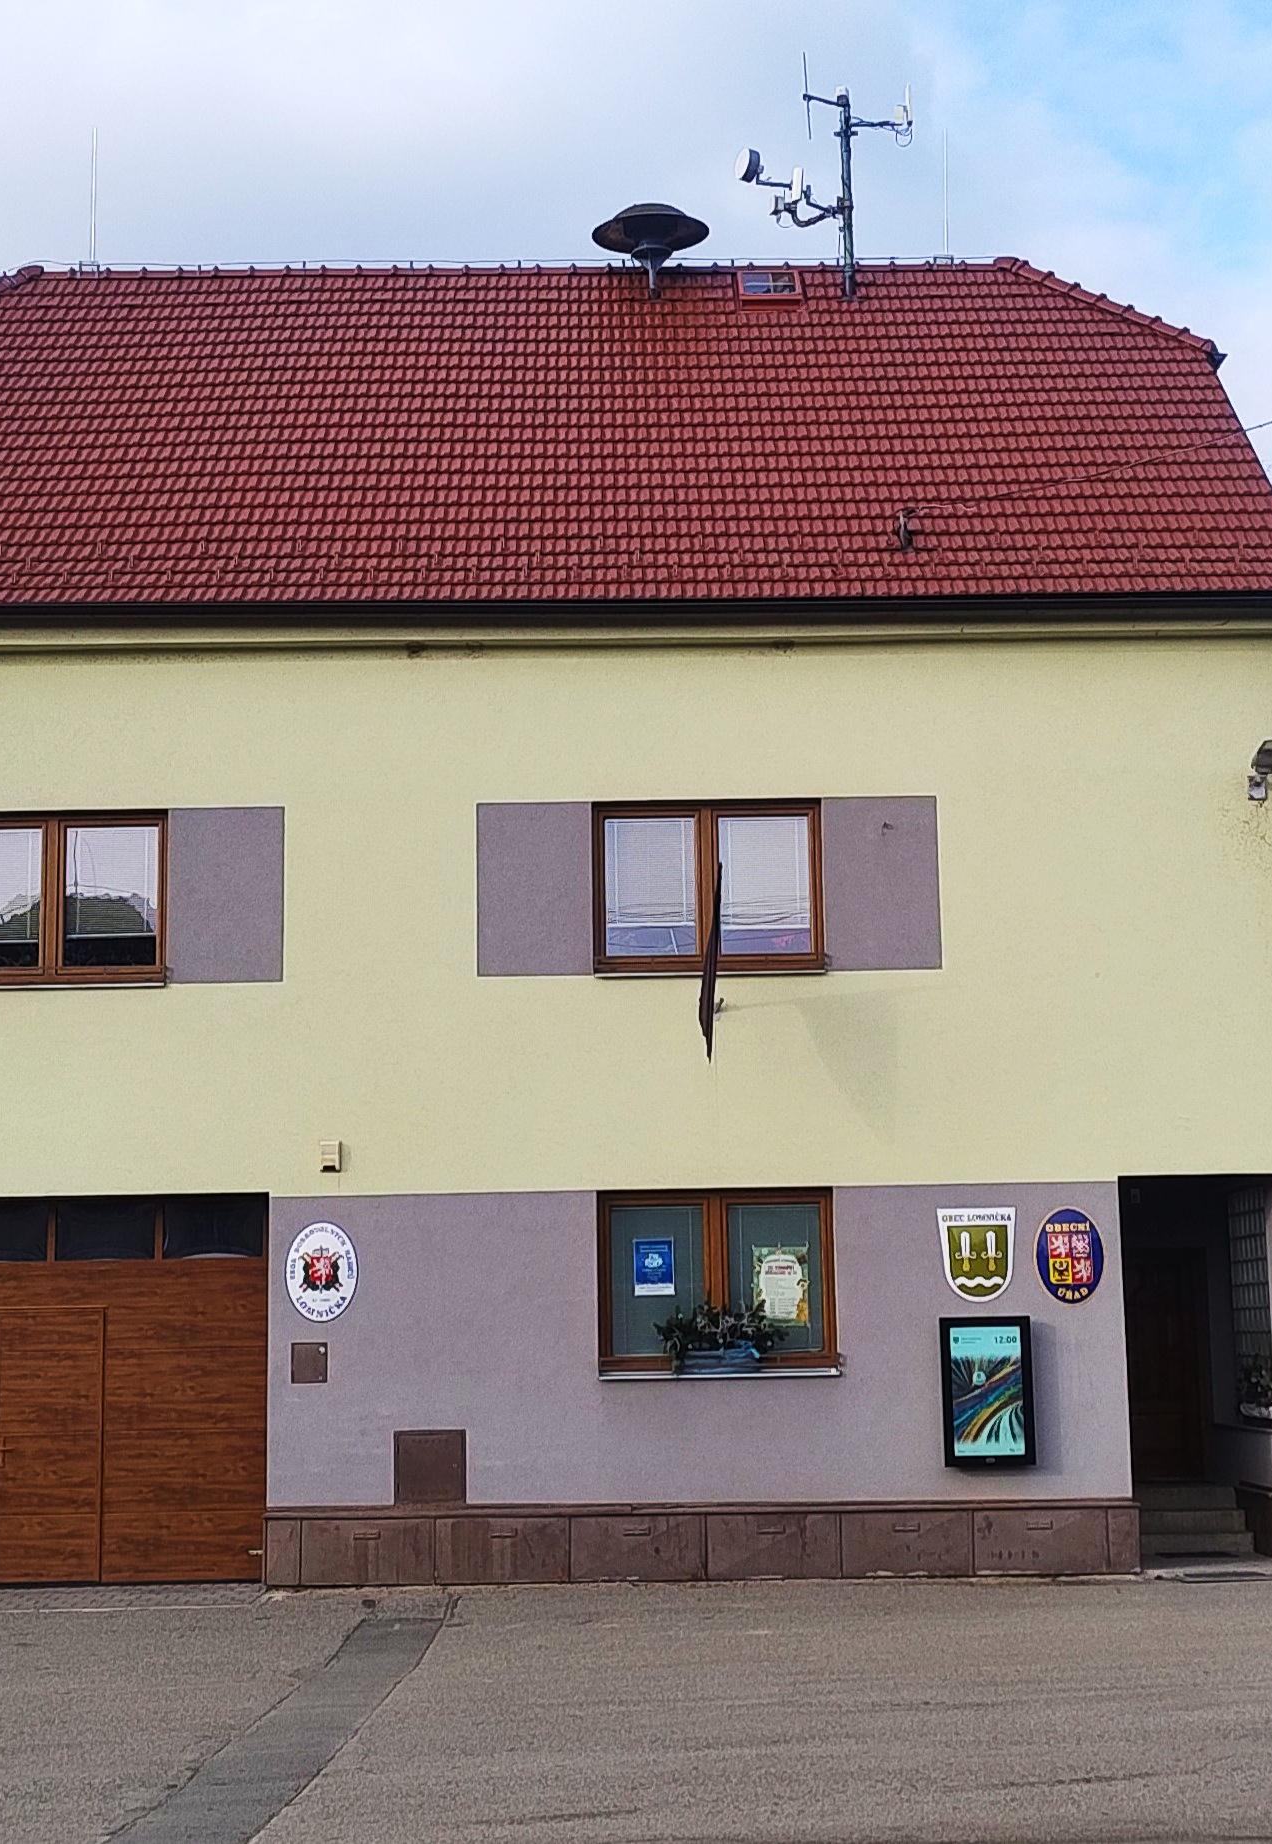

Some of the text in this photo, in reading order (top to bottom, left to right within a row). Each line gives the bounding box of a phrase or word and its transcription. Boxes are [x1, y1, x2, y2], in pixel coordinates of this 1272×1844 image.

[942, 1211, 1012, 1223] OBEC LOMNIČKA
[1046, 1220, 1091, 1233] OBECNÍ
[1057, 1286, 1089, 1301] ÚŘAD
[296, 1295, 347, 1318] LOMNIČKA
